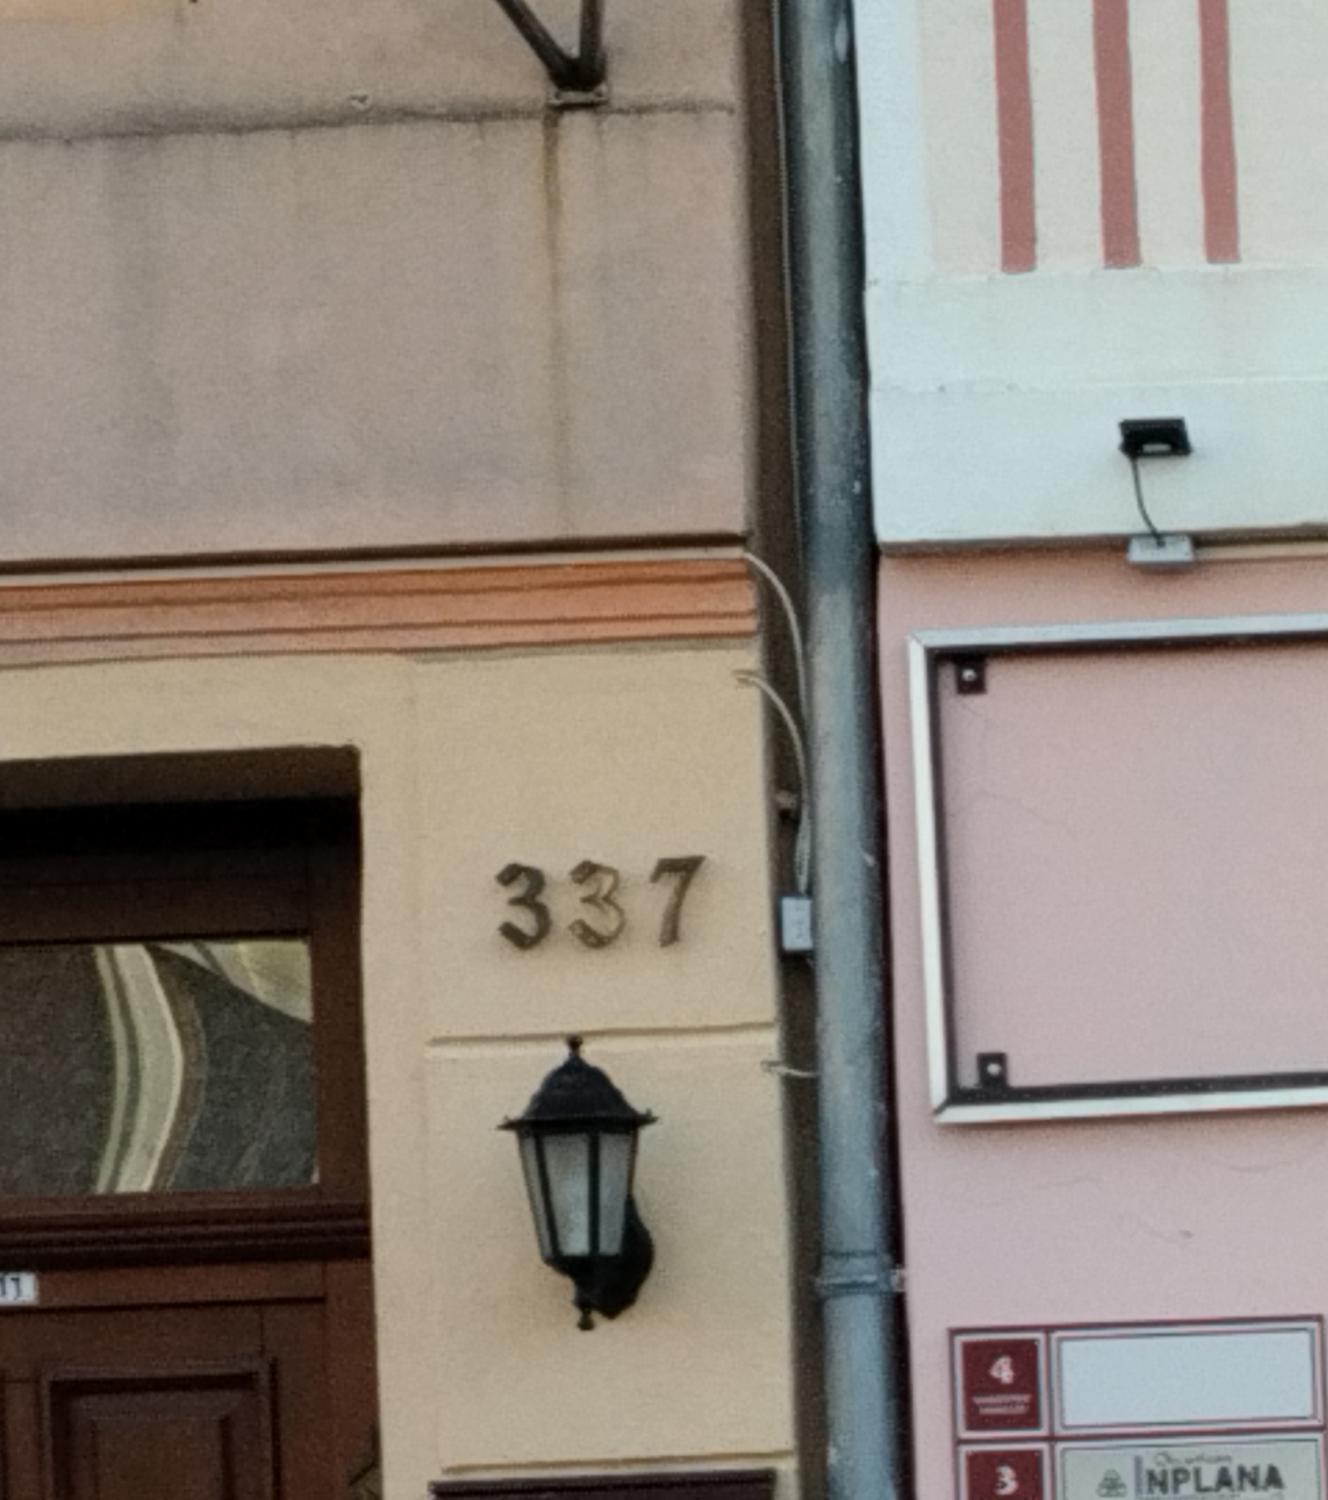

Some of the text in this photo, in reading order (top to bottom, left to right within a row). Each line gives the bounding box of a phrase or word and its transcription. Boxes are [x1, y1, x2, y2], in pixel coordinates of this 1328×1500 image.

[496, 855, 706, 949] 337
[988, 1355, 1015, 1384] 4
[994, 1465, 1019, 1495] 3
